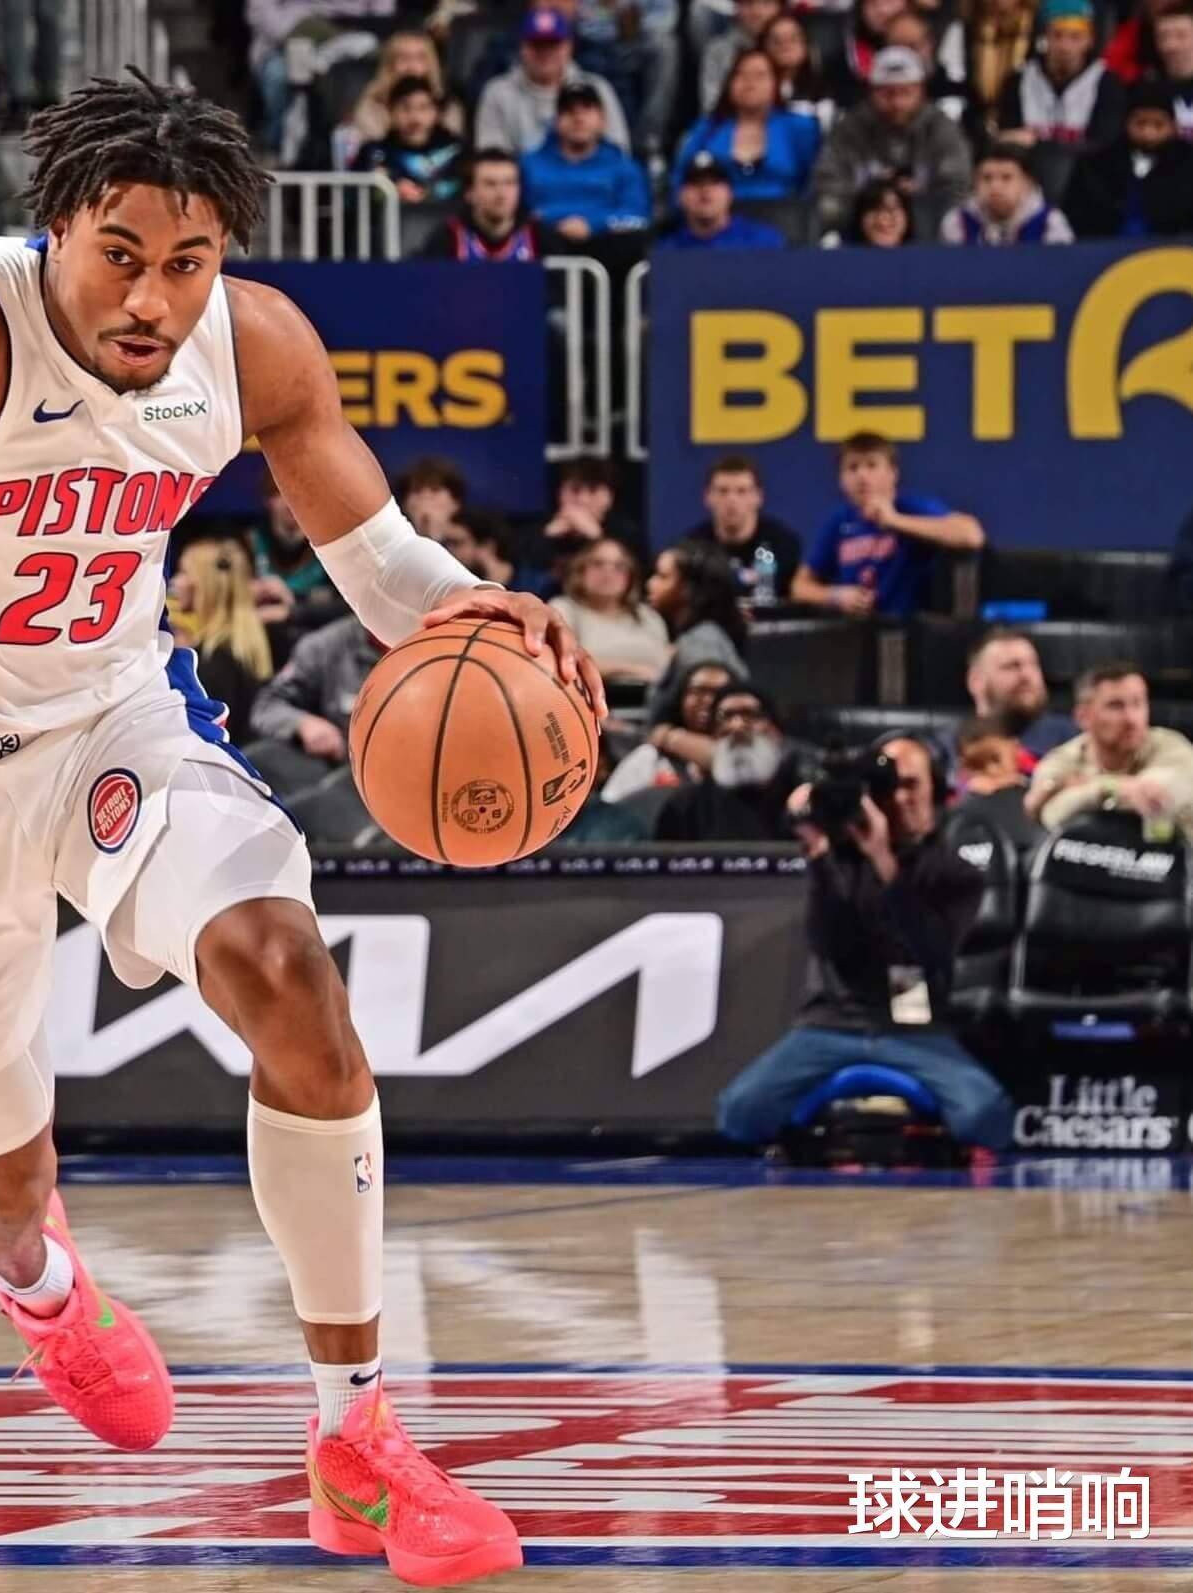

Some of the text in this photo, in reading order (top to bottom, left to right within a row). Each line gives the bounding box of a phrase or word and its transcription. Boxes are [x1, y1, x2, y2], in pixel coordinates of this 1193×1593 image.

[143, 400, 207, 422] StockX
[1049, 1074, 1159, 1116] Little
[1012, 1105, 1174, 1150] Caesars
